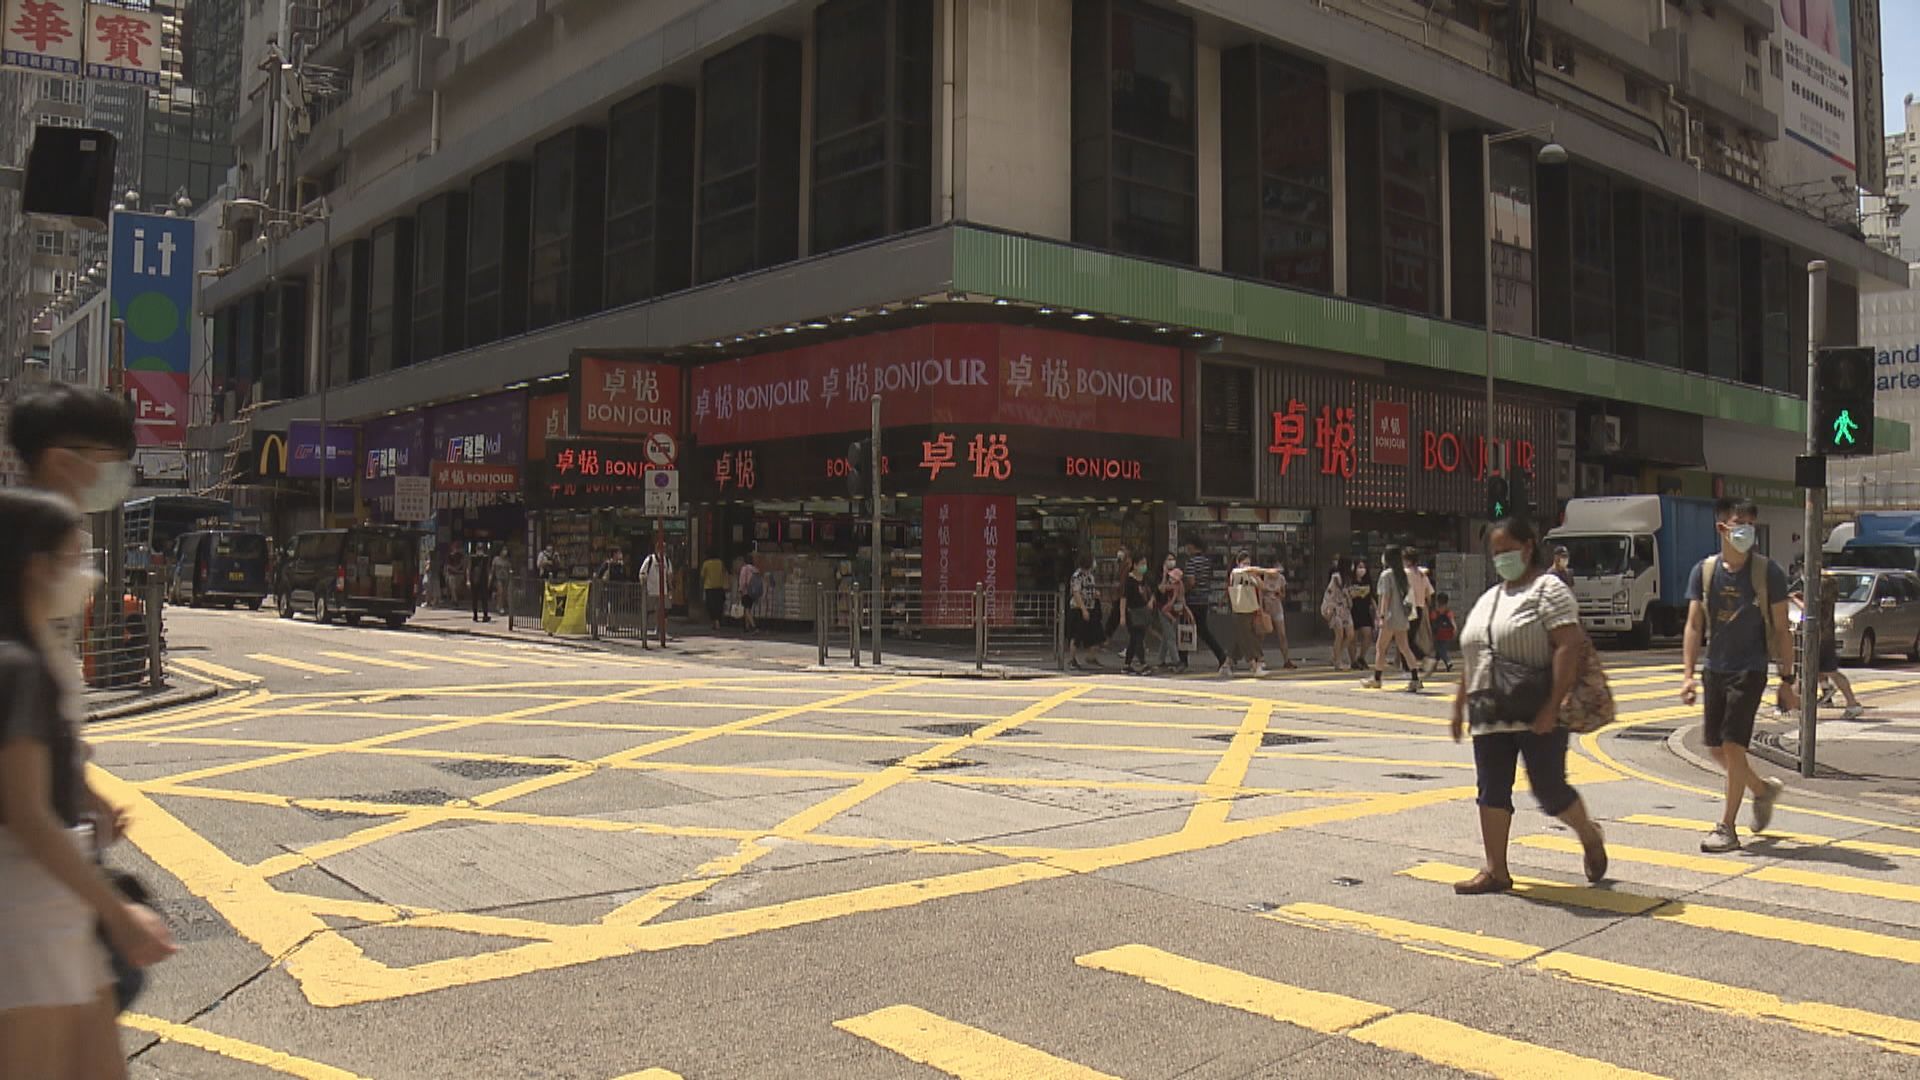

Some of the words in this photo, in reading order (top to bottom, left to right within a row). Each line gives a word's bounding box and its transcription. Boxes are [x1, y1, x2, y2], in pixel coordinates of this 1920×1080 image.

[10, 0, 73, 52] 華
[133, 228, 177, 277] i.t
[874, 358, 988, 393] BONJOUR
[1077, 367, 1174, 403] BONJOUR
[736, 378, 810, 412] BONJOUR
[587, 403, 672, 426] BONJOUR
[1375, 436, 1406, 449] BONJOUR
[467, 471, 514, 484] BONJOUR
[1066, 456, 1142, 480] BONJOUR
